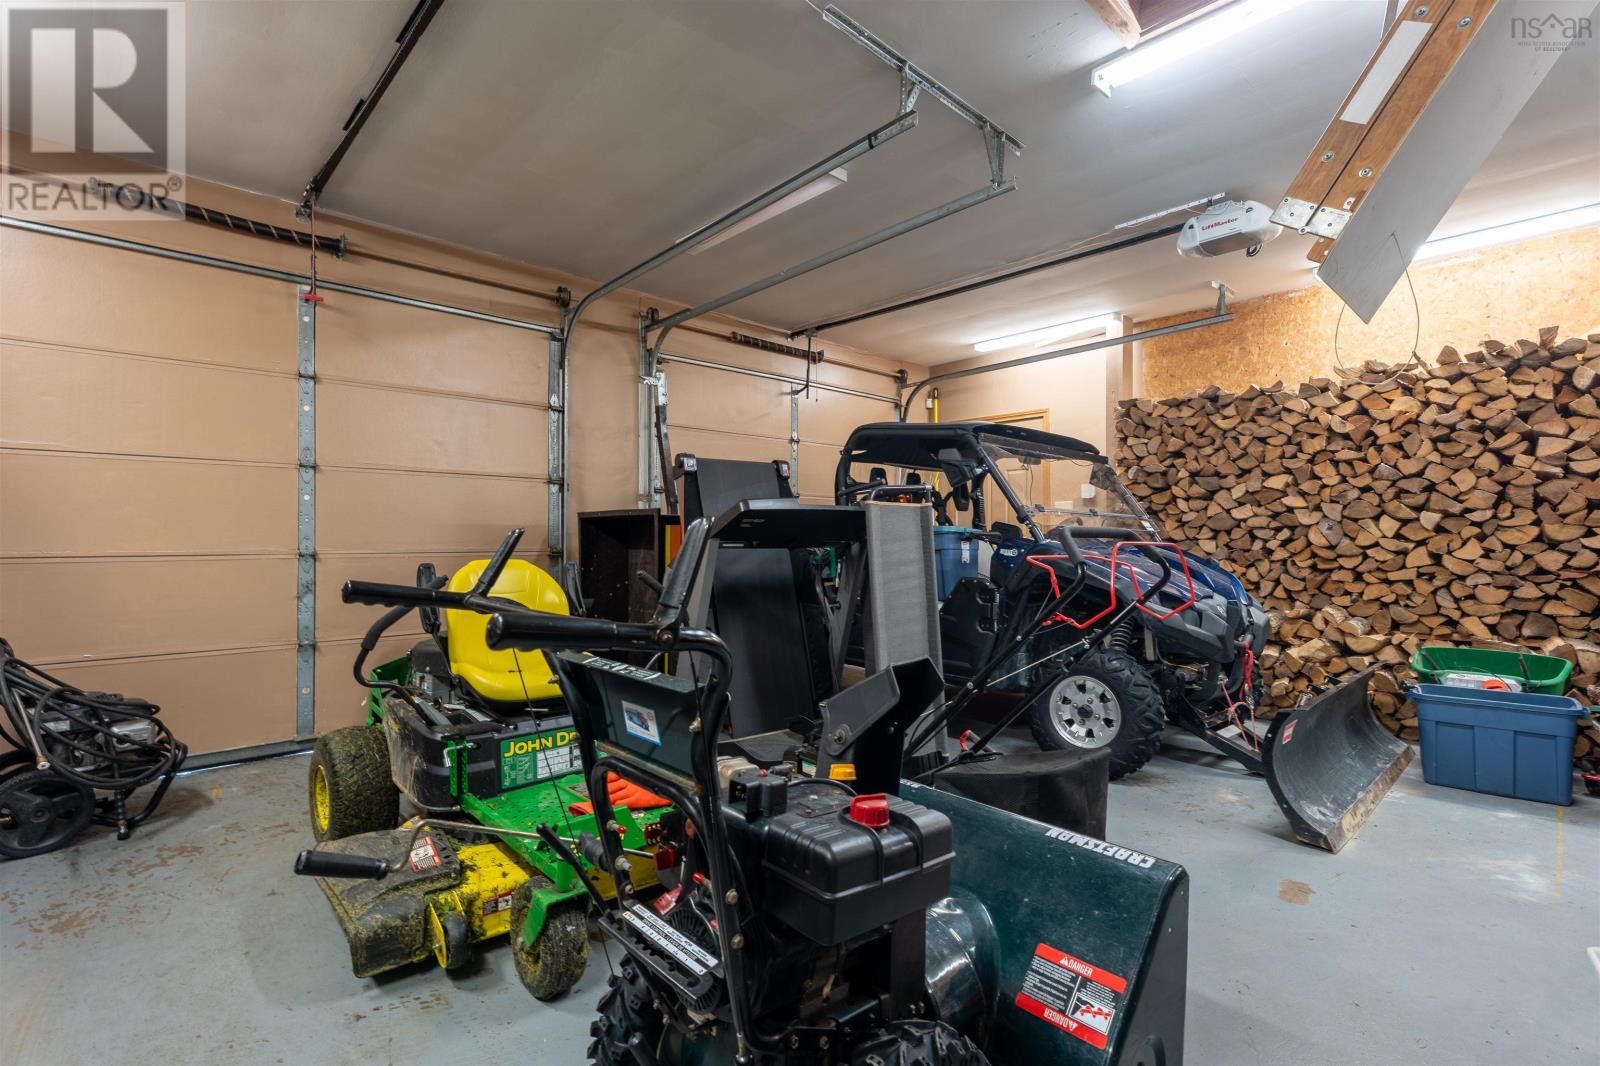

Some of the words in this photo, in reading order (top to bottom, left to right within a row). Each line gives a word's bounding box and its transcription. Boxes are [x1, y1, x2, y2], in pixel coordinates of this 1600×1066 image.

[1201, 217, 1239, 231] LiftMaster
[504, 737, 553, 757] JOHN
[1045, 827, 1156, 869] CRAFTSMAN
[1068, 959, 1094, 977] DANGER
[1043, 1007, 1070, 1028] DANGER
